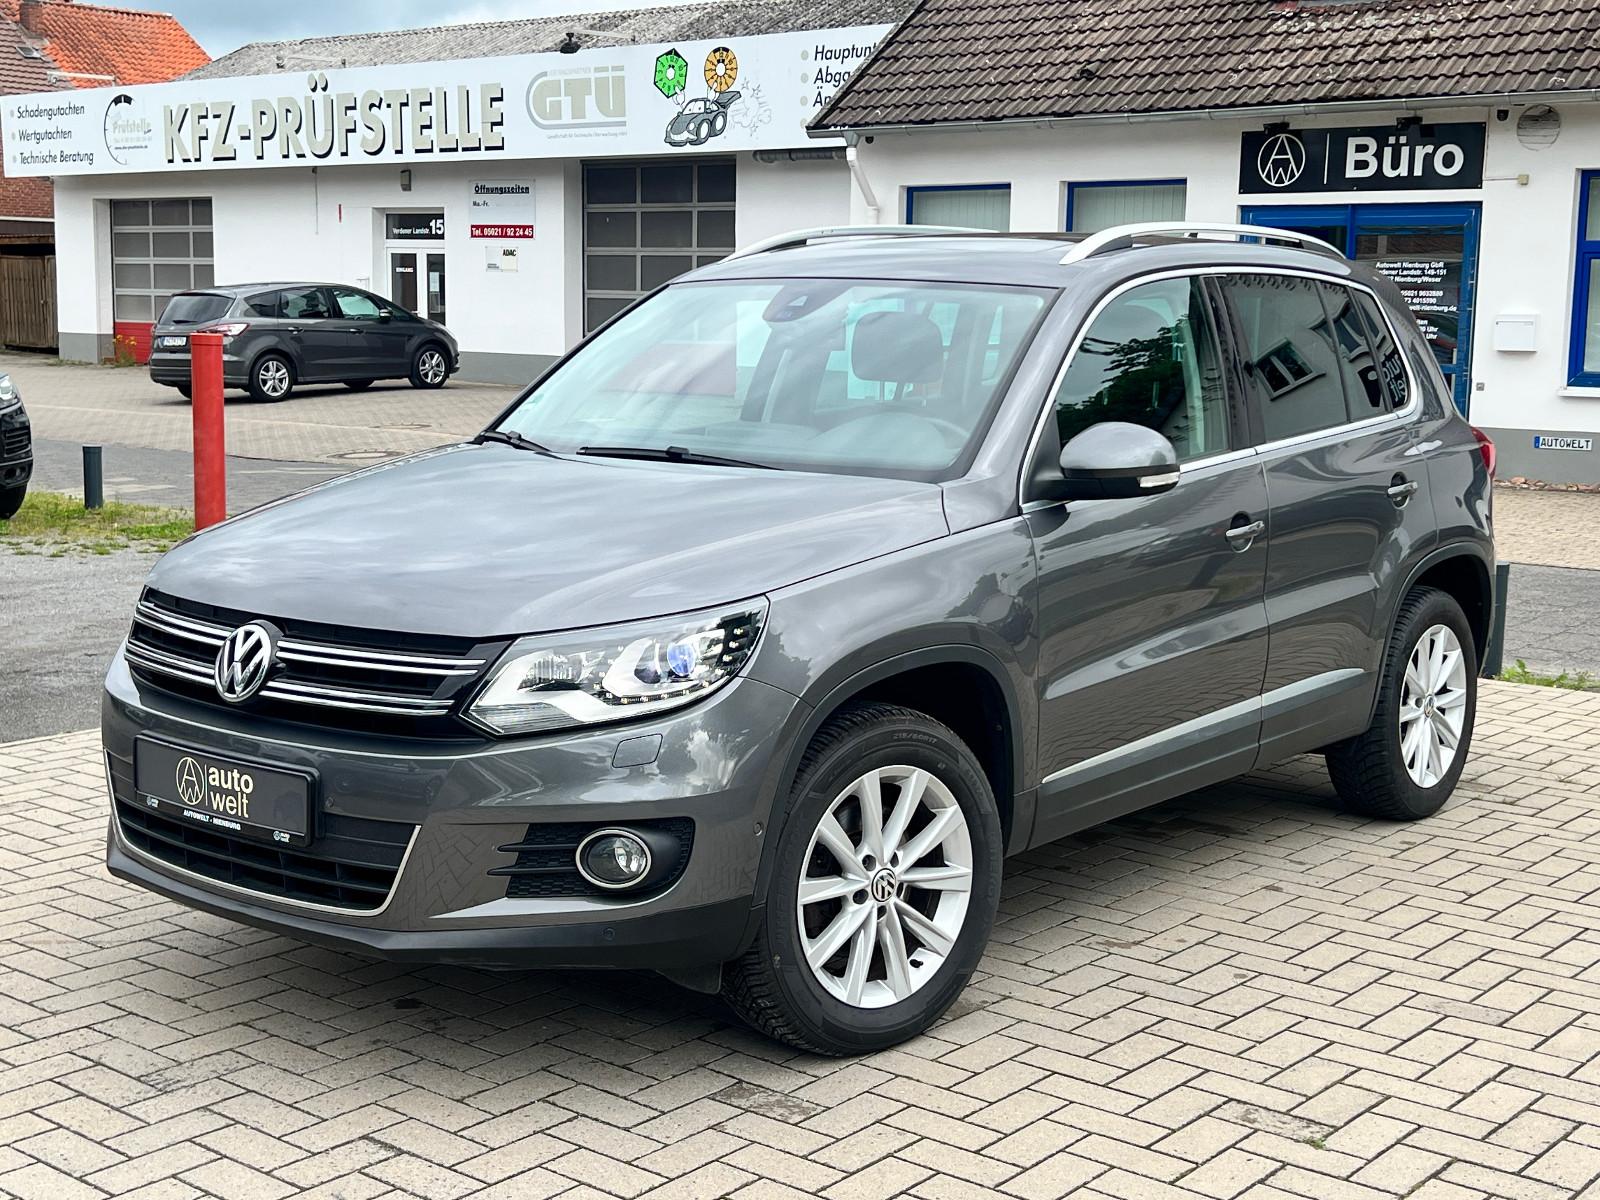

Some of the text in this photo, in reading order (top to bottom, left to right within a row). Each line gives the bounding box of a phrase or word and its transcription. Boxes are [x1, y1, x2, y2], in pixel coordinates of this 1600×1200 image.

[531, 64, 626, 121] GTÜ
[17, 101, 85, 121] Schadengutachten
[163, 72, 504, 163] KFZ-PRÜFSTELLE
[18, 126, 72, 144] Wertgutachten
[19, 149, 94, 166] Technische Beratung
[1344, 135, 1465, 179] Büro
[474, 182, 530, 195] Öffnungszeiten
[429, 219, 444, 235] 15
[471, 227, 483, 236] Tel.
[483, 227, 502, 236] 05021
[506, 227, 514, 236] 92
[515, 227, 523, 236] 24
[524, 227, 533, 236] 45
[502, 248, 517, 257] ADAC
[1375, 261, 1444, 270] Autowelt Nienburg GbR
[1398, 268, 1423, 276] Landstr.
[1394, 275, 1442, 284] Nienburg/Weser
[1540, 437, 1591, 449] AUTOWELT
[208, 766, 254, 794] auto
[210, 791, 249, 818] welt
[183, 809, 241, 831] AUTOWELT NIENBURG
